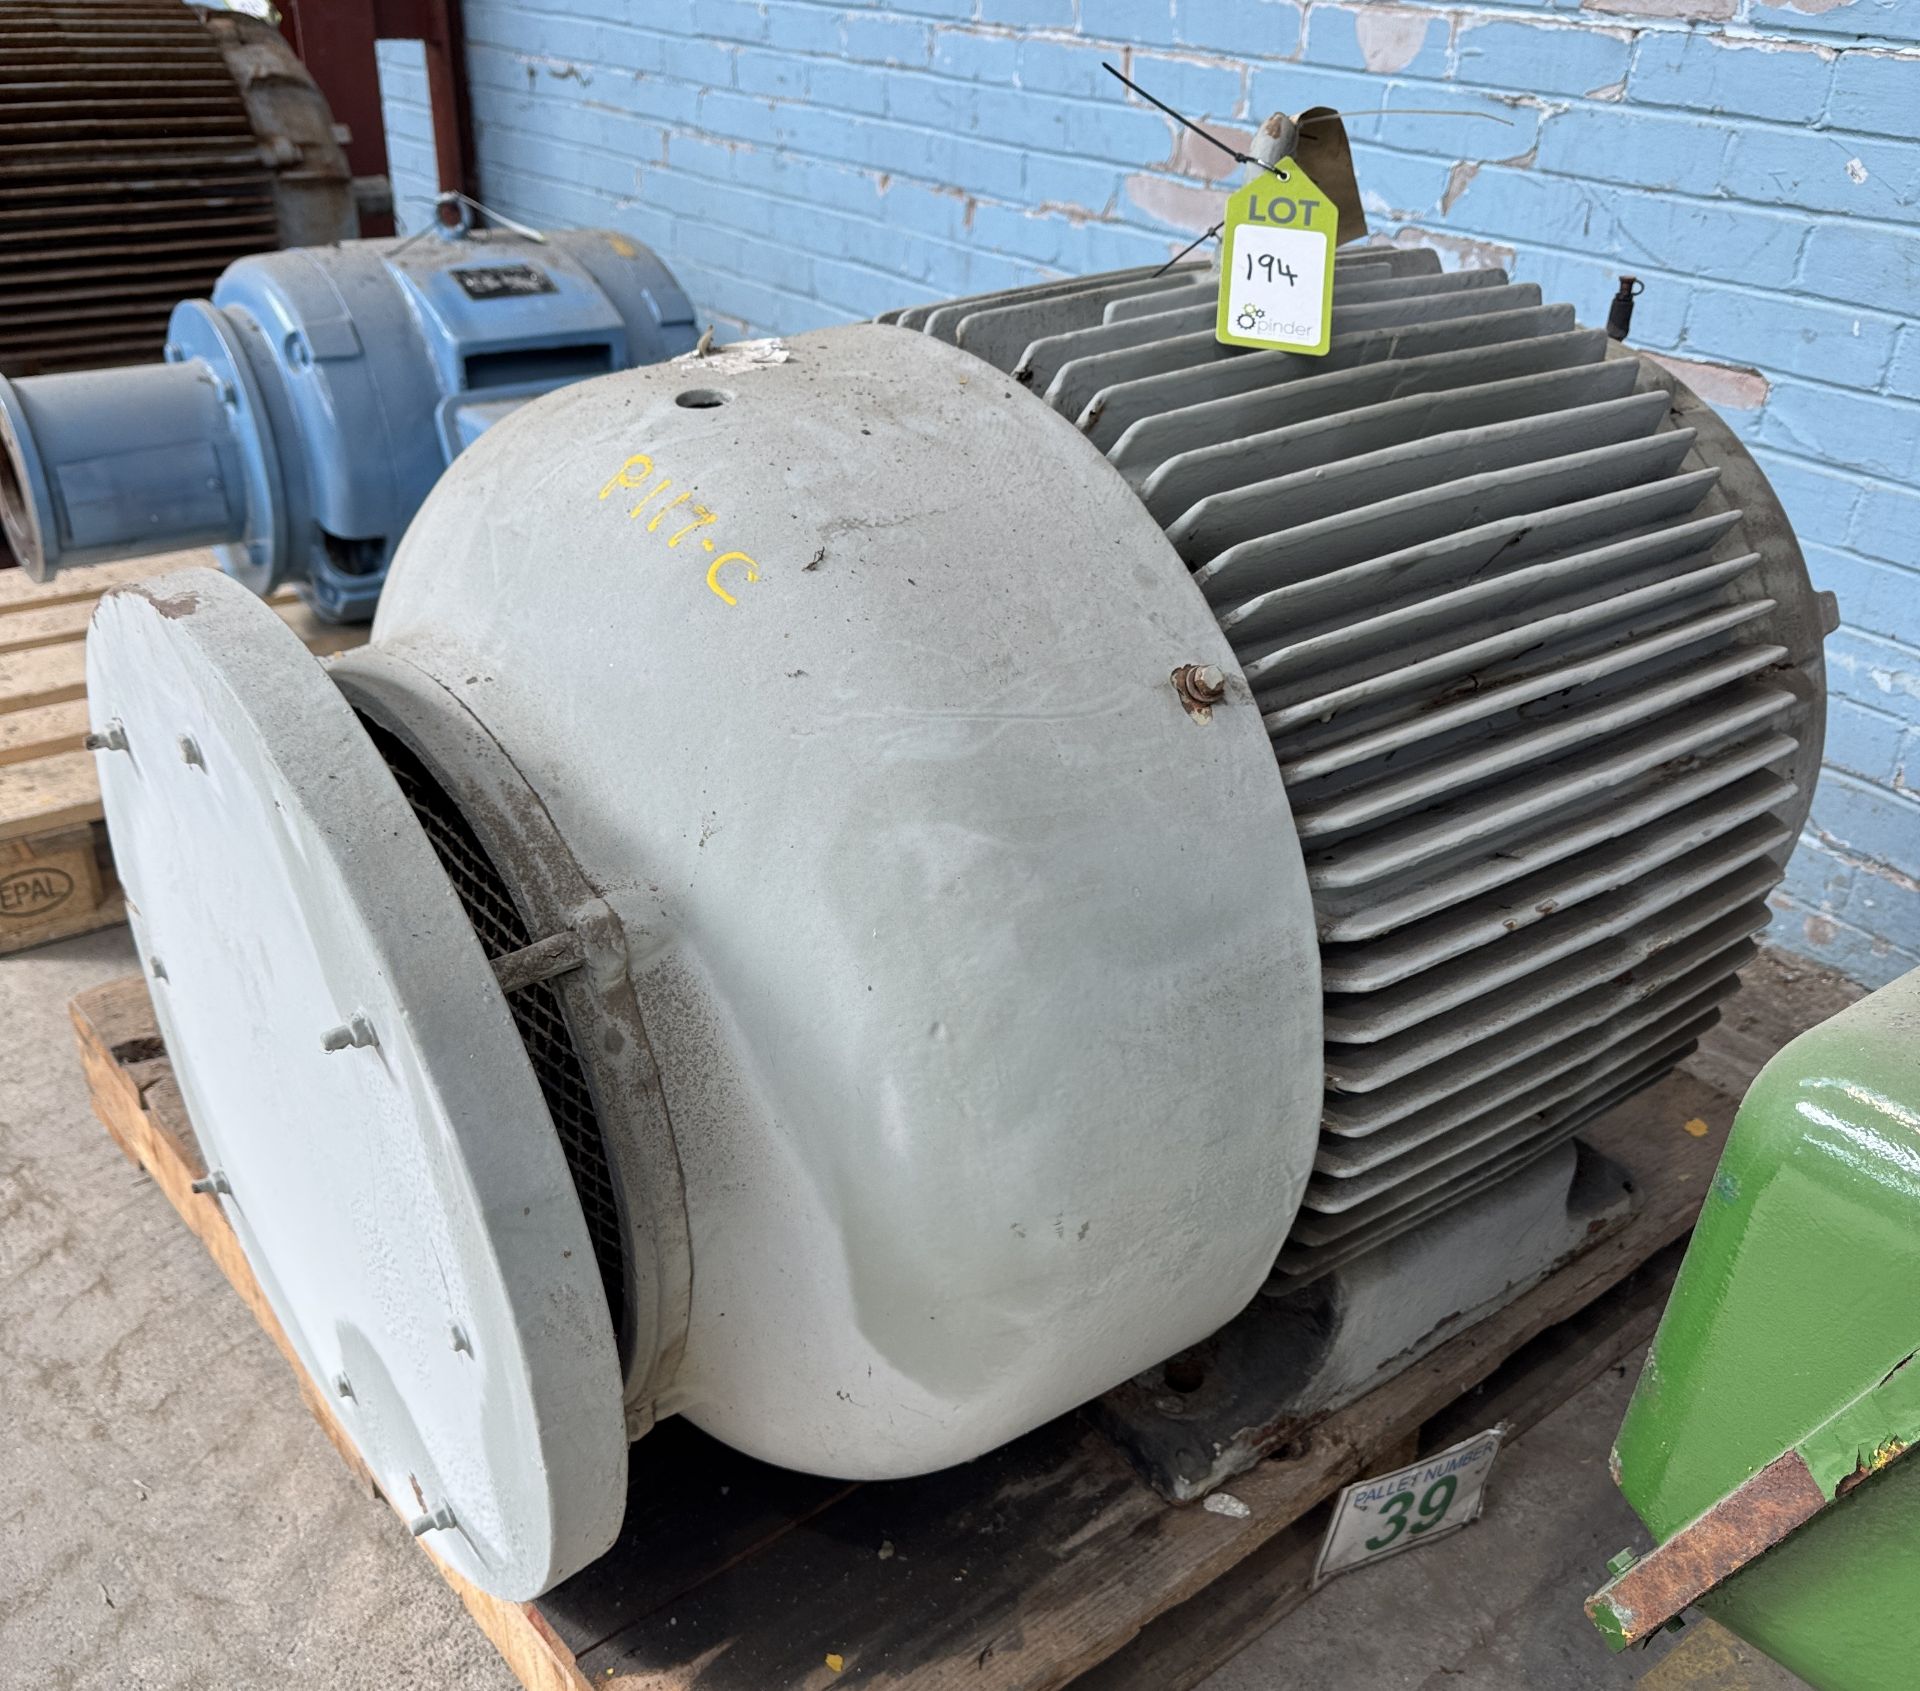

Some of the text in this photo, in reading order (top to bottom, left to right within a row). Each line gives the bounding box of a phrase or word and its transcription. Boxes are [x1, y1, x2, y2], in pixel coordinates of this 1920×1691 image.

[1249, 195, 1320, 226] LOT
[1246, 252, 1298, 287] 194
[1257, 318, 1313, 337] pinder
[0, 874, 59, 910] EPAL
[1354, 1440, 1494, 1506] PALLET NUMBER
[1365, 1474, 1457, 1550] 39
